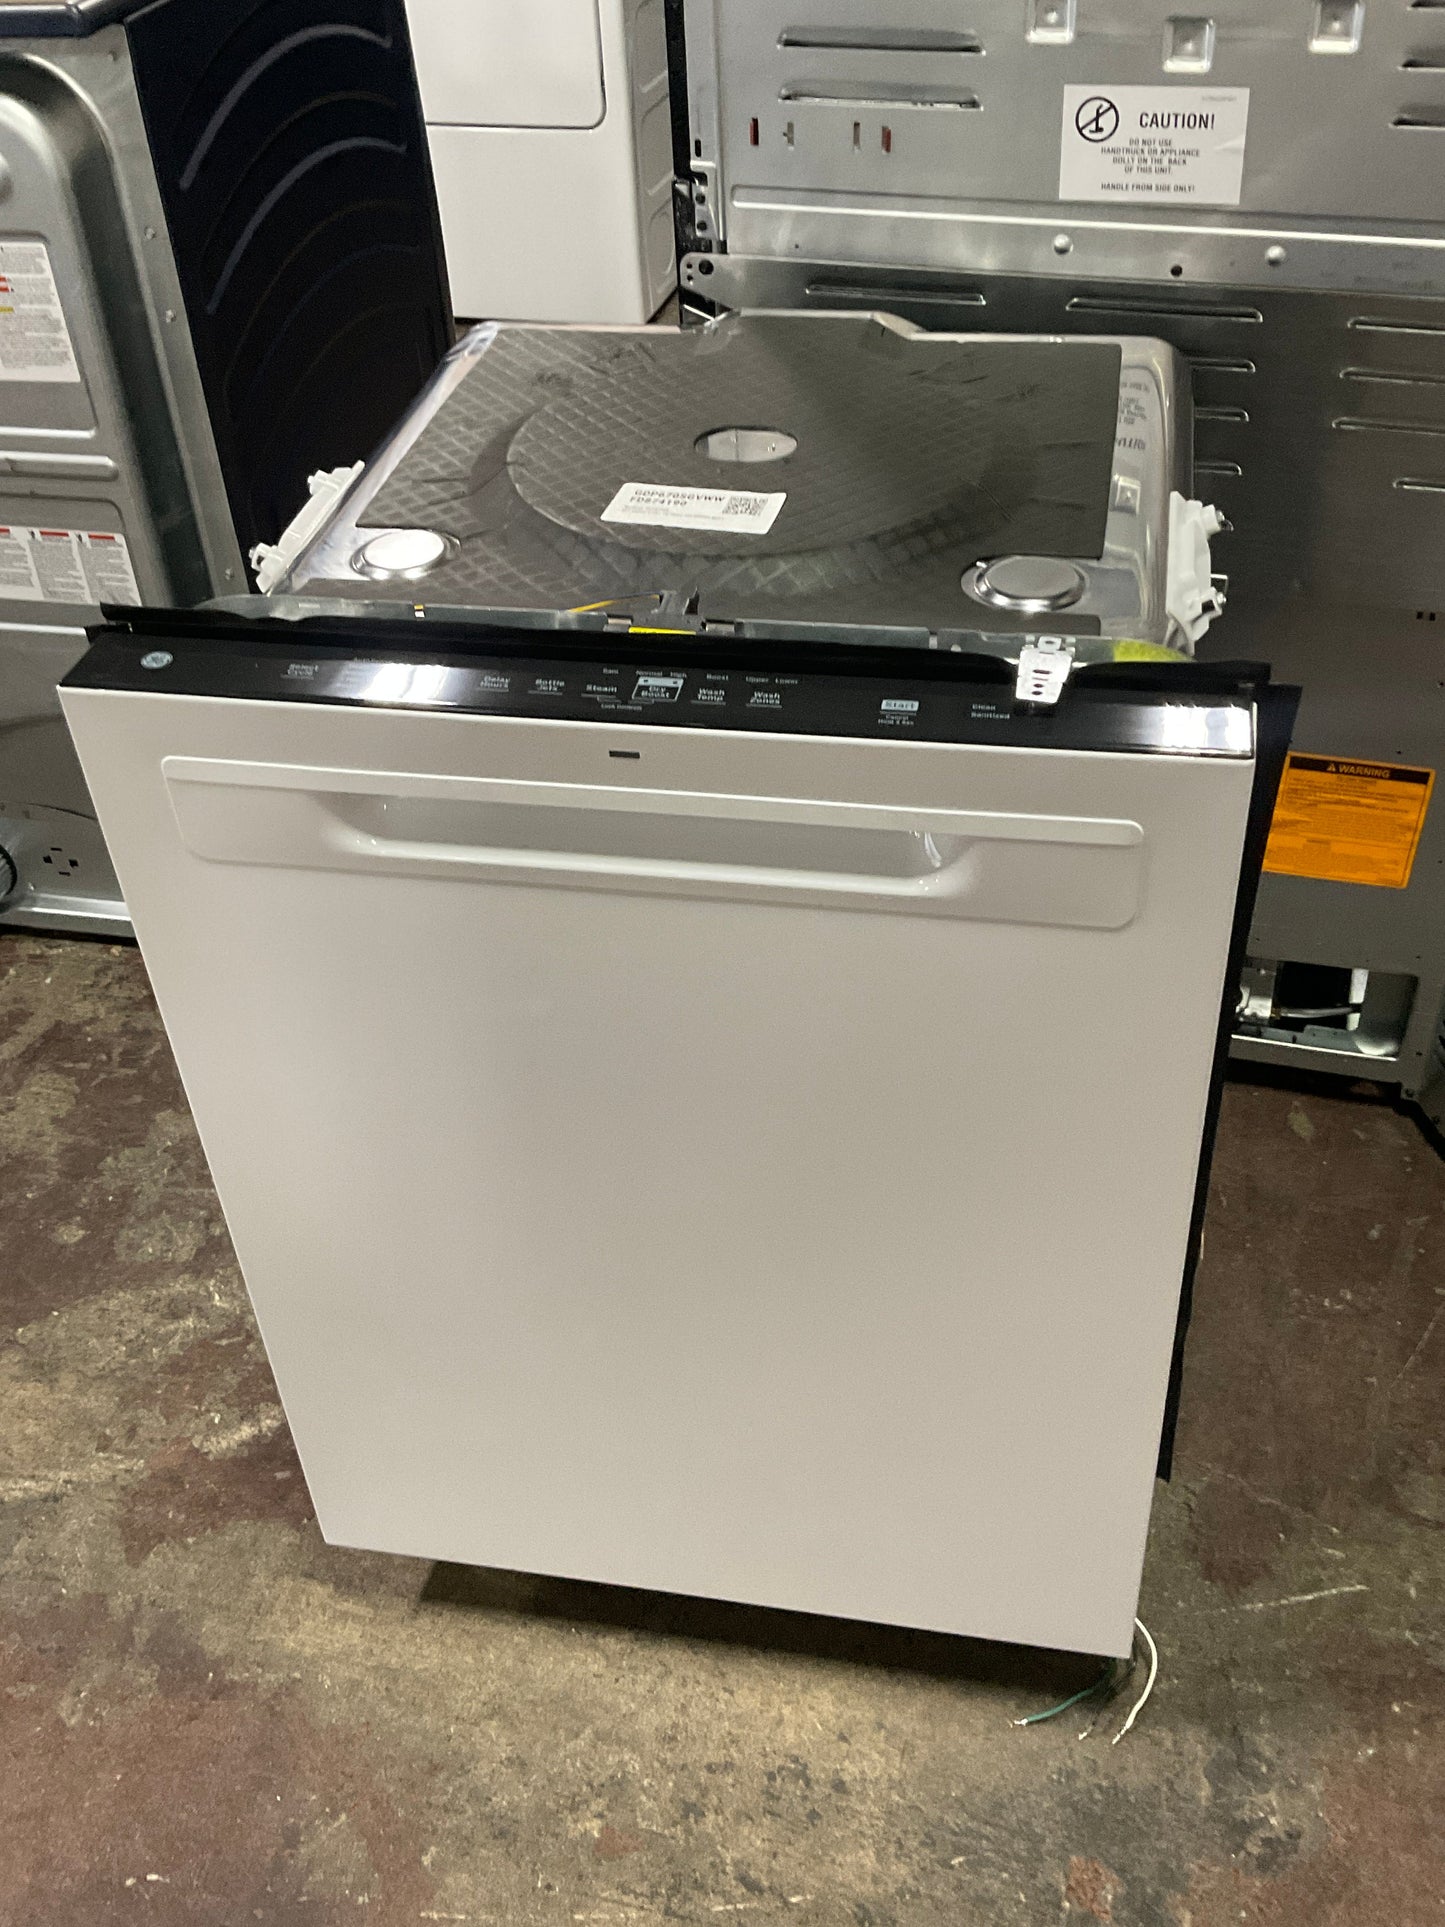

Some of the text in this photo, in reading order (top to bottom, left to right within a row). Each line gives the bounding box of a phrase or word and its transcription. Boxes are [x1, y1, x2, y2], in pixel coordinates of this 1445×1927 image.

[1139, 112, 1215, 130] CAUTION!
[1129, 138, 1172, 147] DO NOT USE
[1101, 146, 1200, 157] HANDTRUCK OR APPLIANCE
[1112, 156, 1187, 166] DOLLY ON THE BACK
[1124, 166, 1133, 174] OF
[1136, 166, 1152, 174] THIS
[1101, 183, 1195, 192] HANDLE FROM SIDE ONLY!
[483, 675, 511, 683] Delay
[535, 679, 565, 687] Bottle
[586, 684, 617, 693] Steam
[699, 687, 725, 696] Wash
[641, 690, 669, 698] Boost
[698, 694, 724, 702] Temp
[754, 691, 780, 699] Wash
[885, 701, 915, 709] Start
[1339, 764, 1391, 779] WARNING
